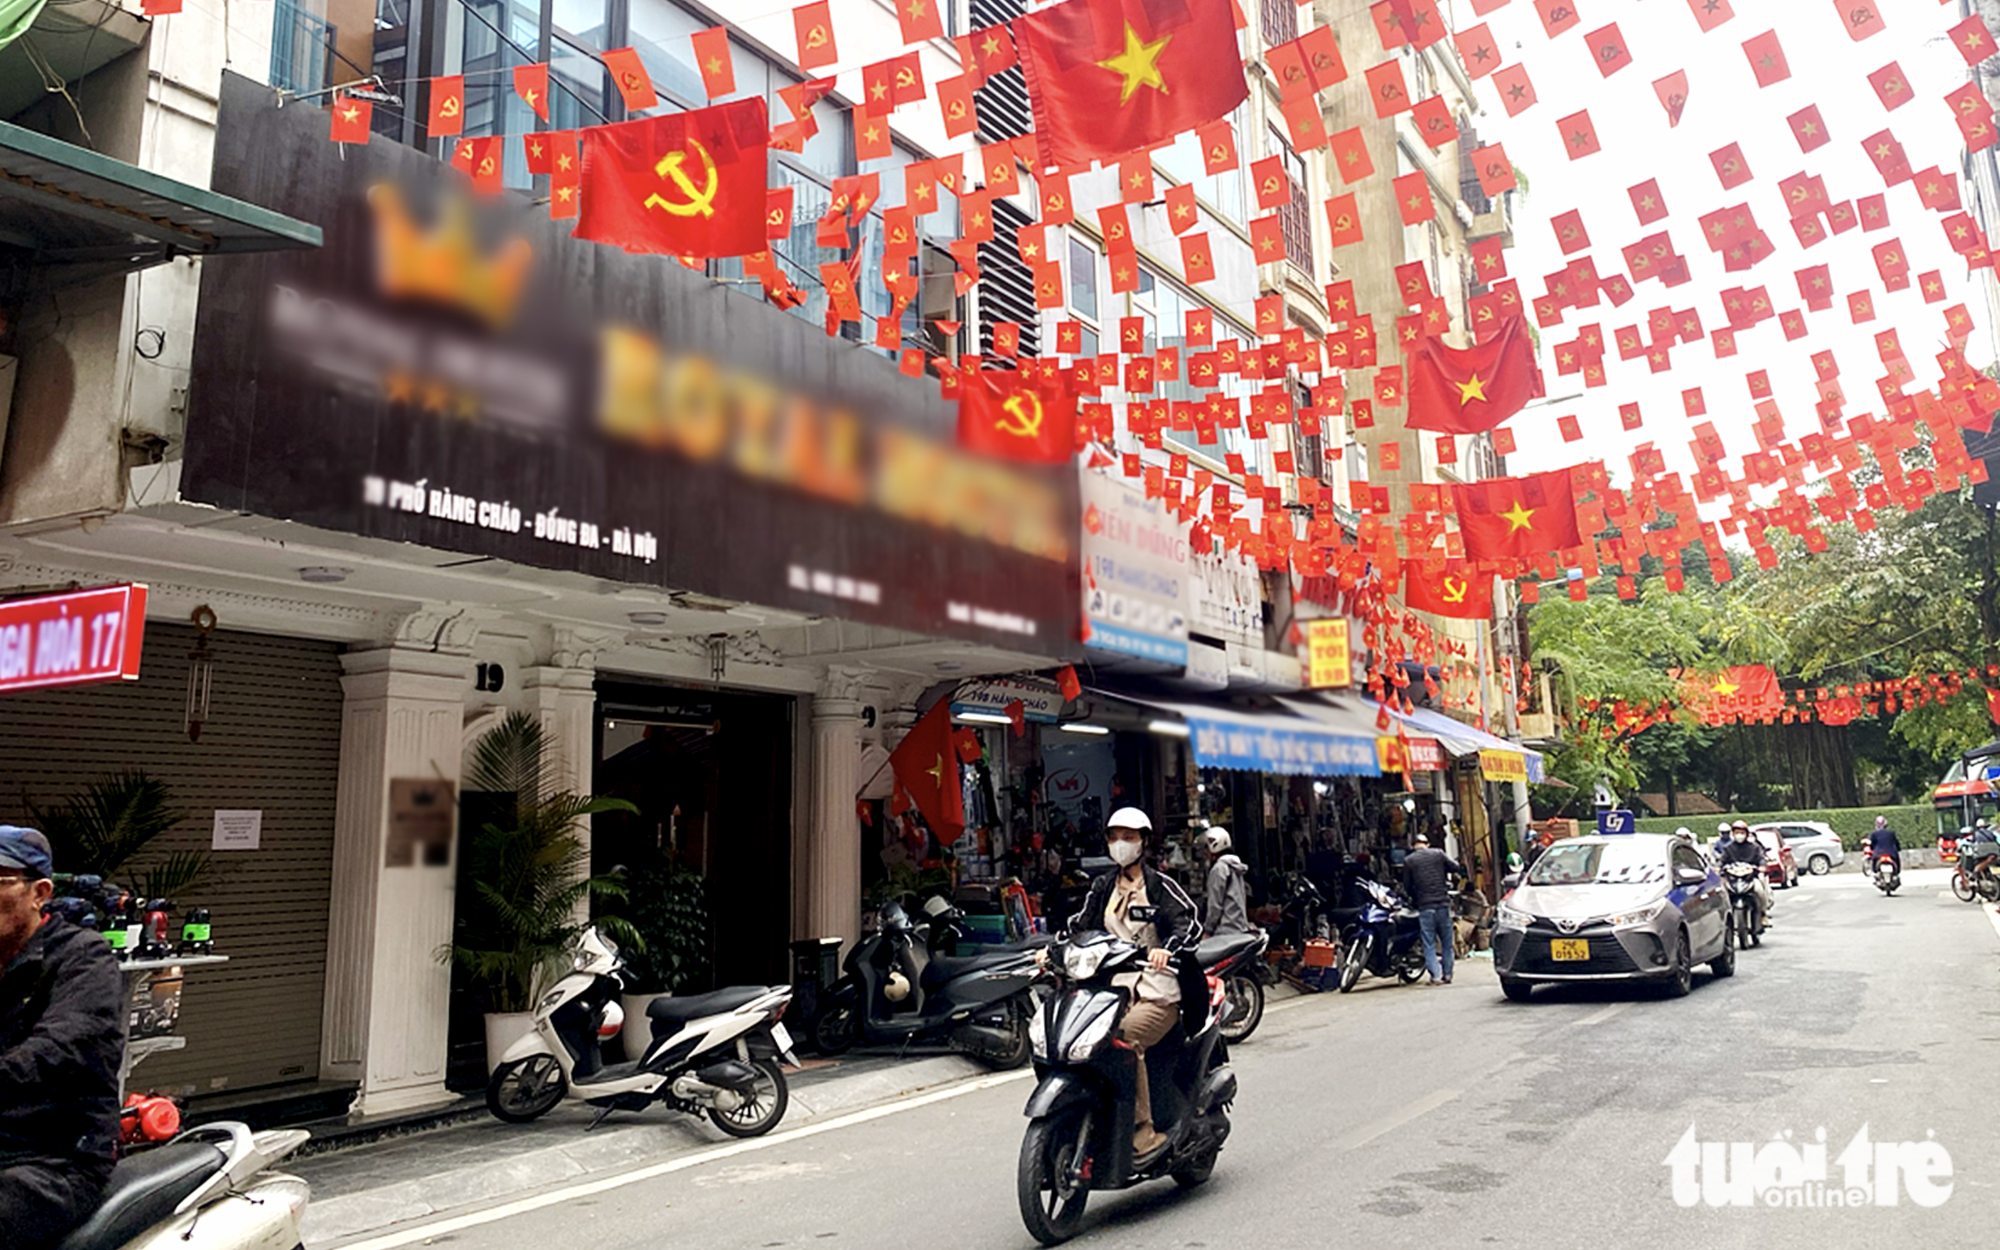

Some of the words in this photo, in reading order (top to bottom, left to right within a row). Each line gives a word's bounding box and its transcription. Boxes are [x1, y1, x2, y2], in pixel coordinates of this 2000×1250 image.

[389, 478, 428, 514] PHỐ
[428, 487, 476, 525] HÀNG
[478, 501, 522, 533] CHÁO
[534, 507, 577, 546] ĐỐNG
[579, 522, 600, 549] ĐA
[612, 527, 633, 558] HÀ
[634, 532, 657, 564] NỘI
[34, 604, 83, 676] HÒA
[90, 610, 121, 670] 17
[475, 662, 504, 693] 19
[1606, 813, 1624, 832] G7
